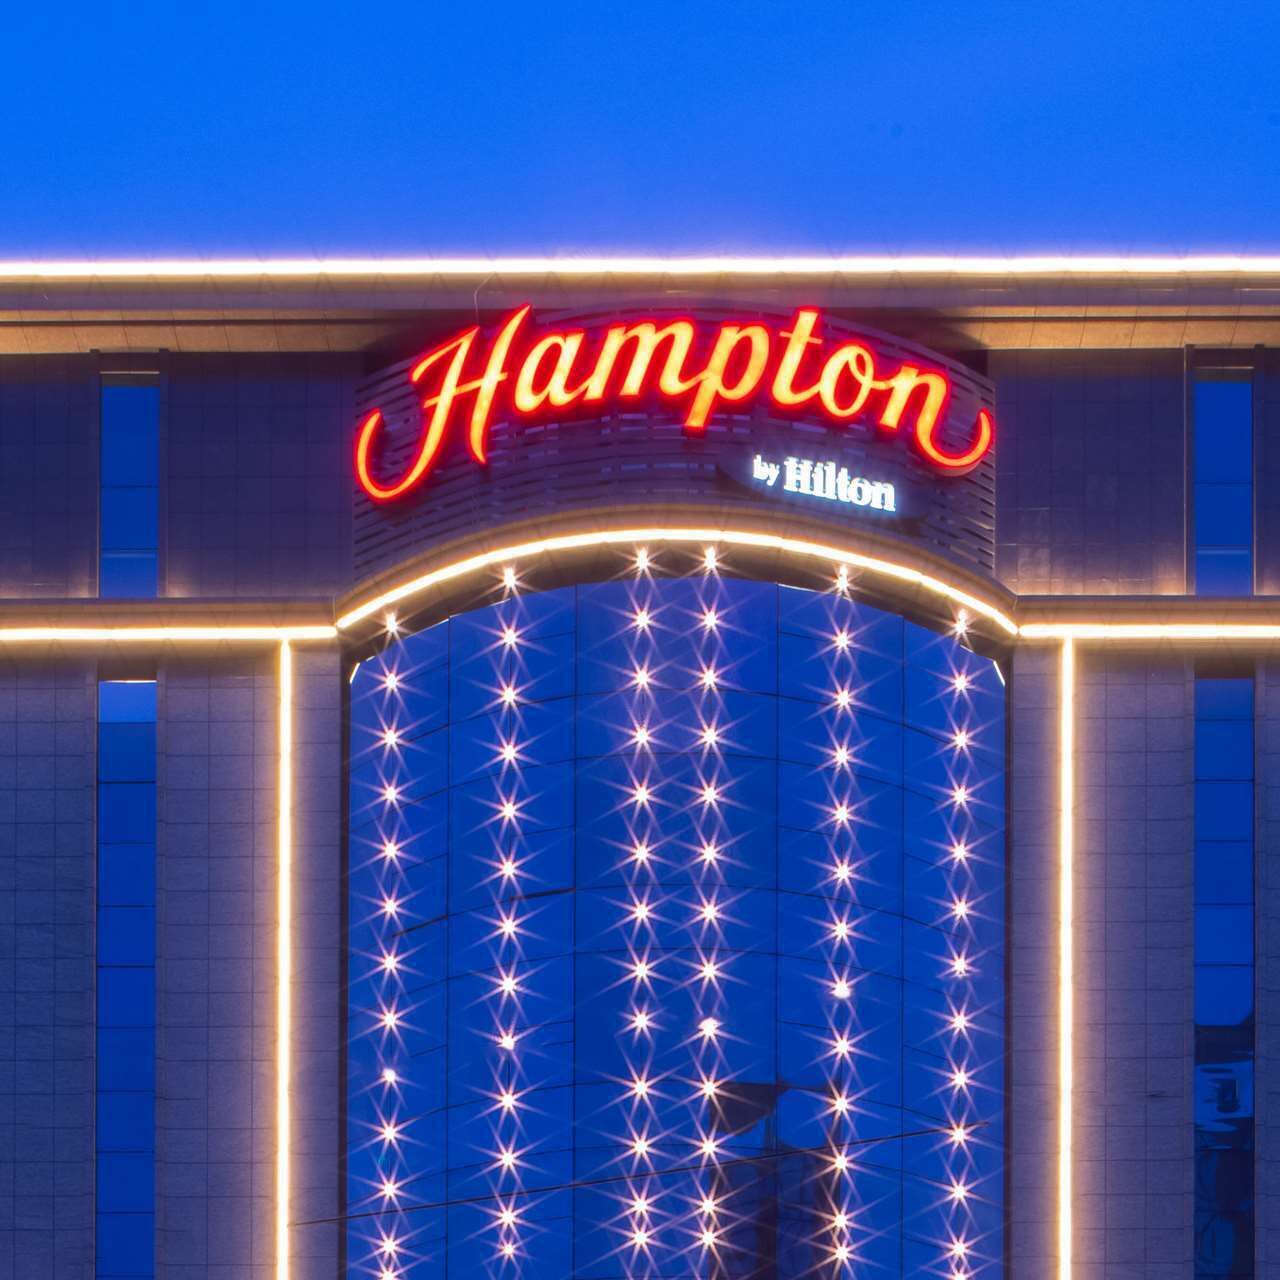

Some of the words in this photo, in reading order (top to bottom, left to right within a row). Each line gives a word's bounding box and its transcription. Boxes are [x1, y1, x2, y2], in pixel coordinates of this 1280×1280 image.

[355, 304, 993, 500] Hampton
[752, 454, 780, 485] by
[783, 456, 896, 512] Hilton
